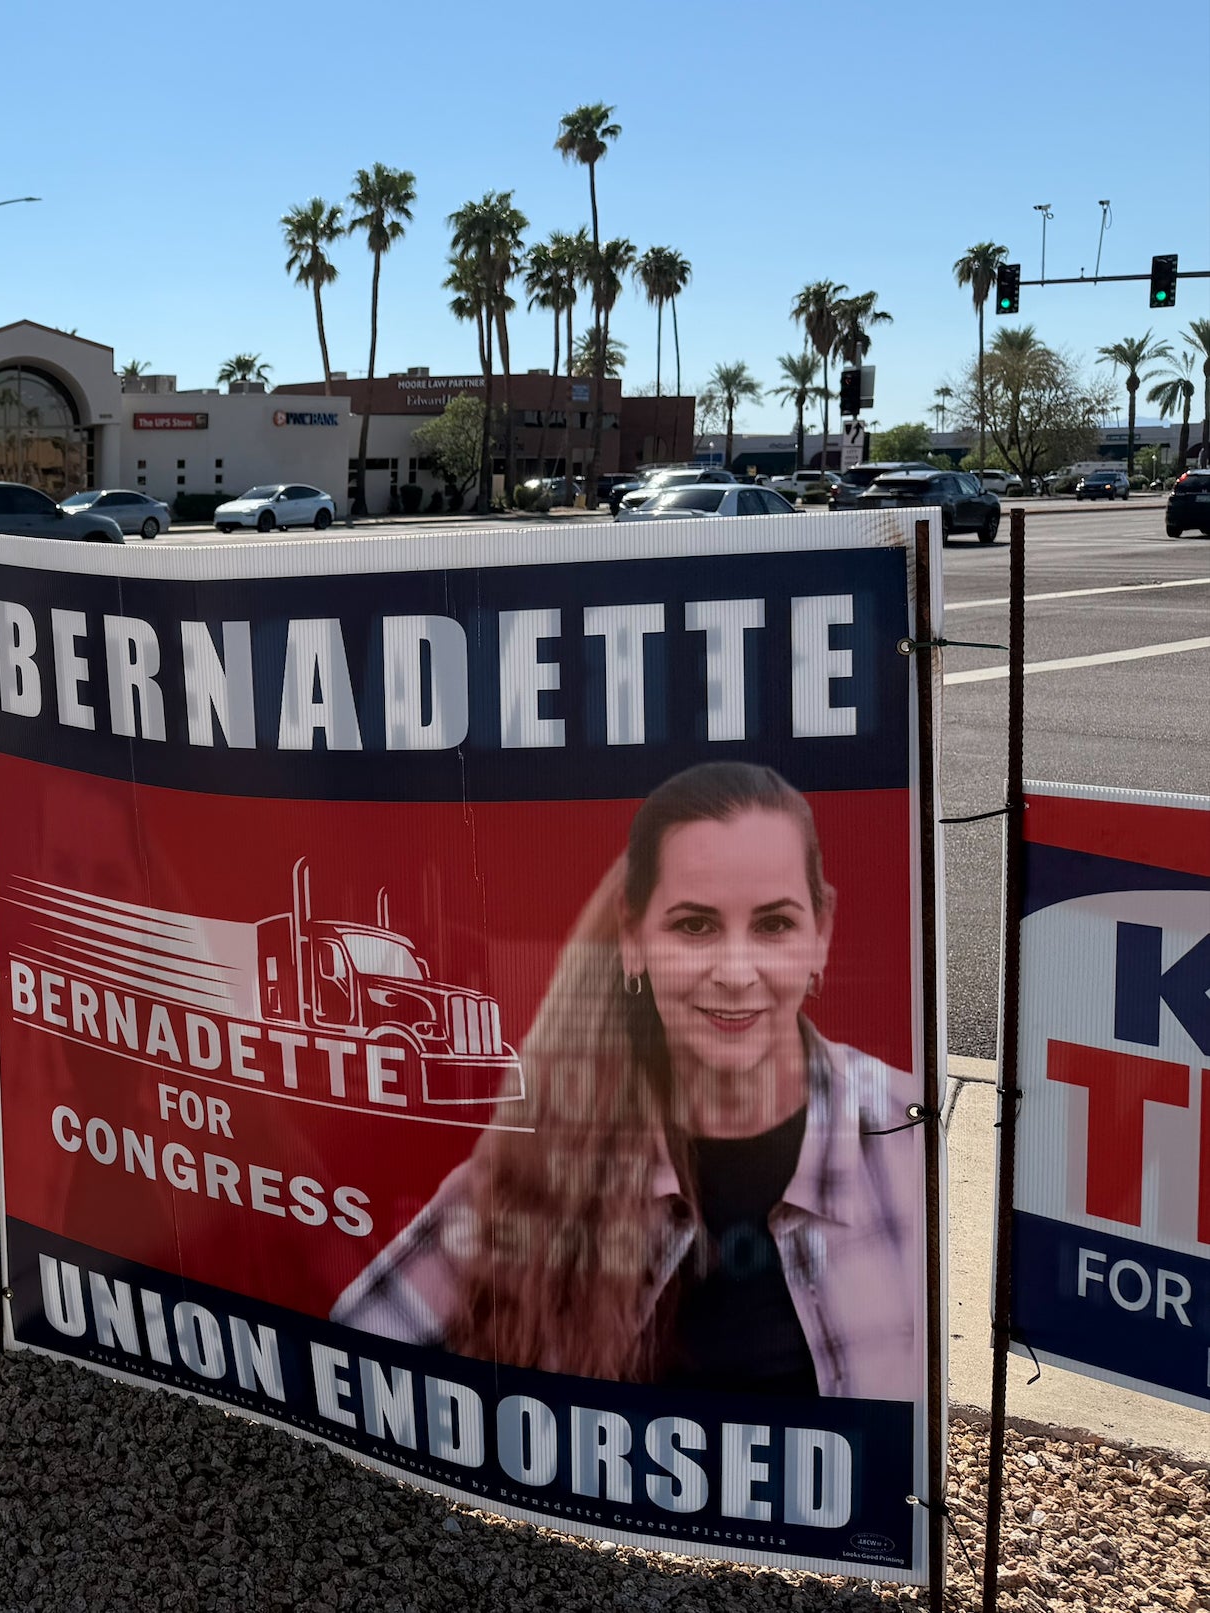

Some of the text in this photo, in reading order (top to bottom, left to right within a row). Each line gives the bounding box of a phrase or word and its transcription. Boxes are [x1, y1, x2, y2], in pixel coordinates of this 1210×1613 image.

[397, 380, 427, 390] MOORE
[428, 380, 447, 389] LAW
[406, 394, 446, 406] Edward
[139, 418, 193, 428] The UPS Store
[286, 412, 339, 426] PNC BANK
[9, 960, 408, 1108] BERNADETTE
[158, 1083, 234, 1139] FOR
[51, 1105, 374, 1238] CONGRESS
[1077, 1247, 1193, 1328] FOR
[38, 1252, 853, 1529] UNION ENDORSED
[291, 1414, 357, 1445] Congress
[372, 1446, 461, 1483] Authorized
[472, 1481, 489, 1493] by
[500, 1488, 602, 1519] Bernadette
[613, 1513, 788, 1547] Greene-Placentia
[861, 1552, 879, 1560] Good
[879, 1554, 905, 1565] Printing
